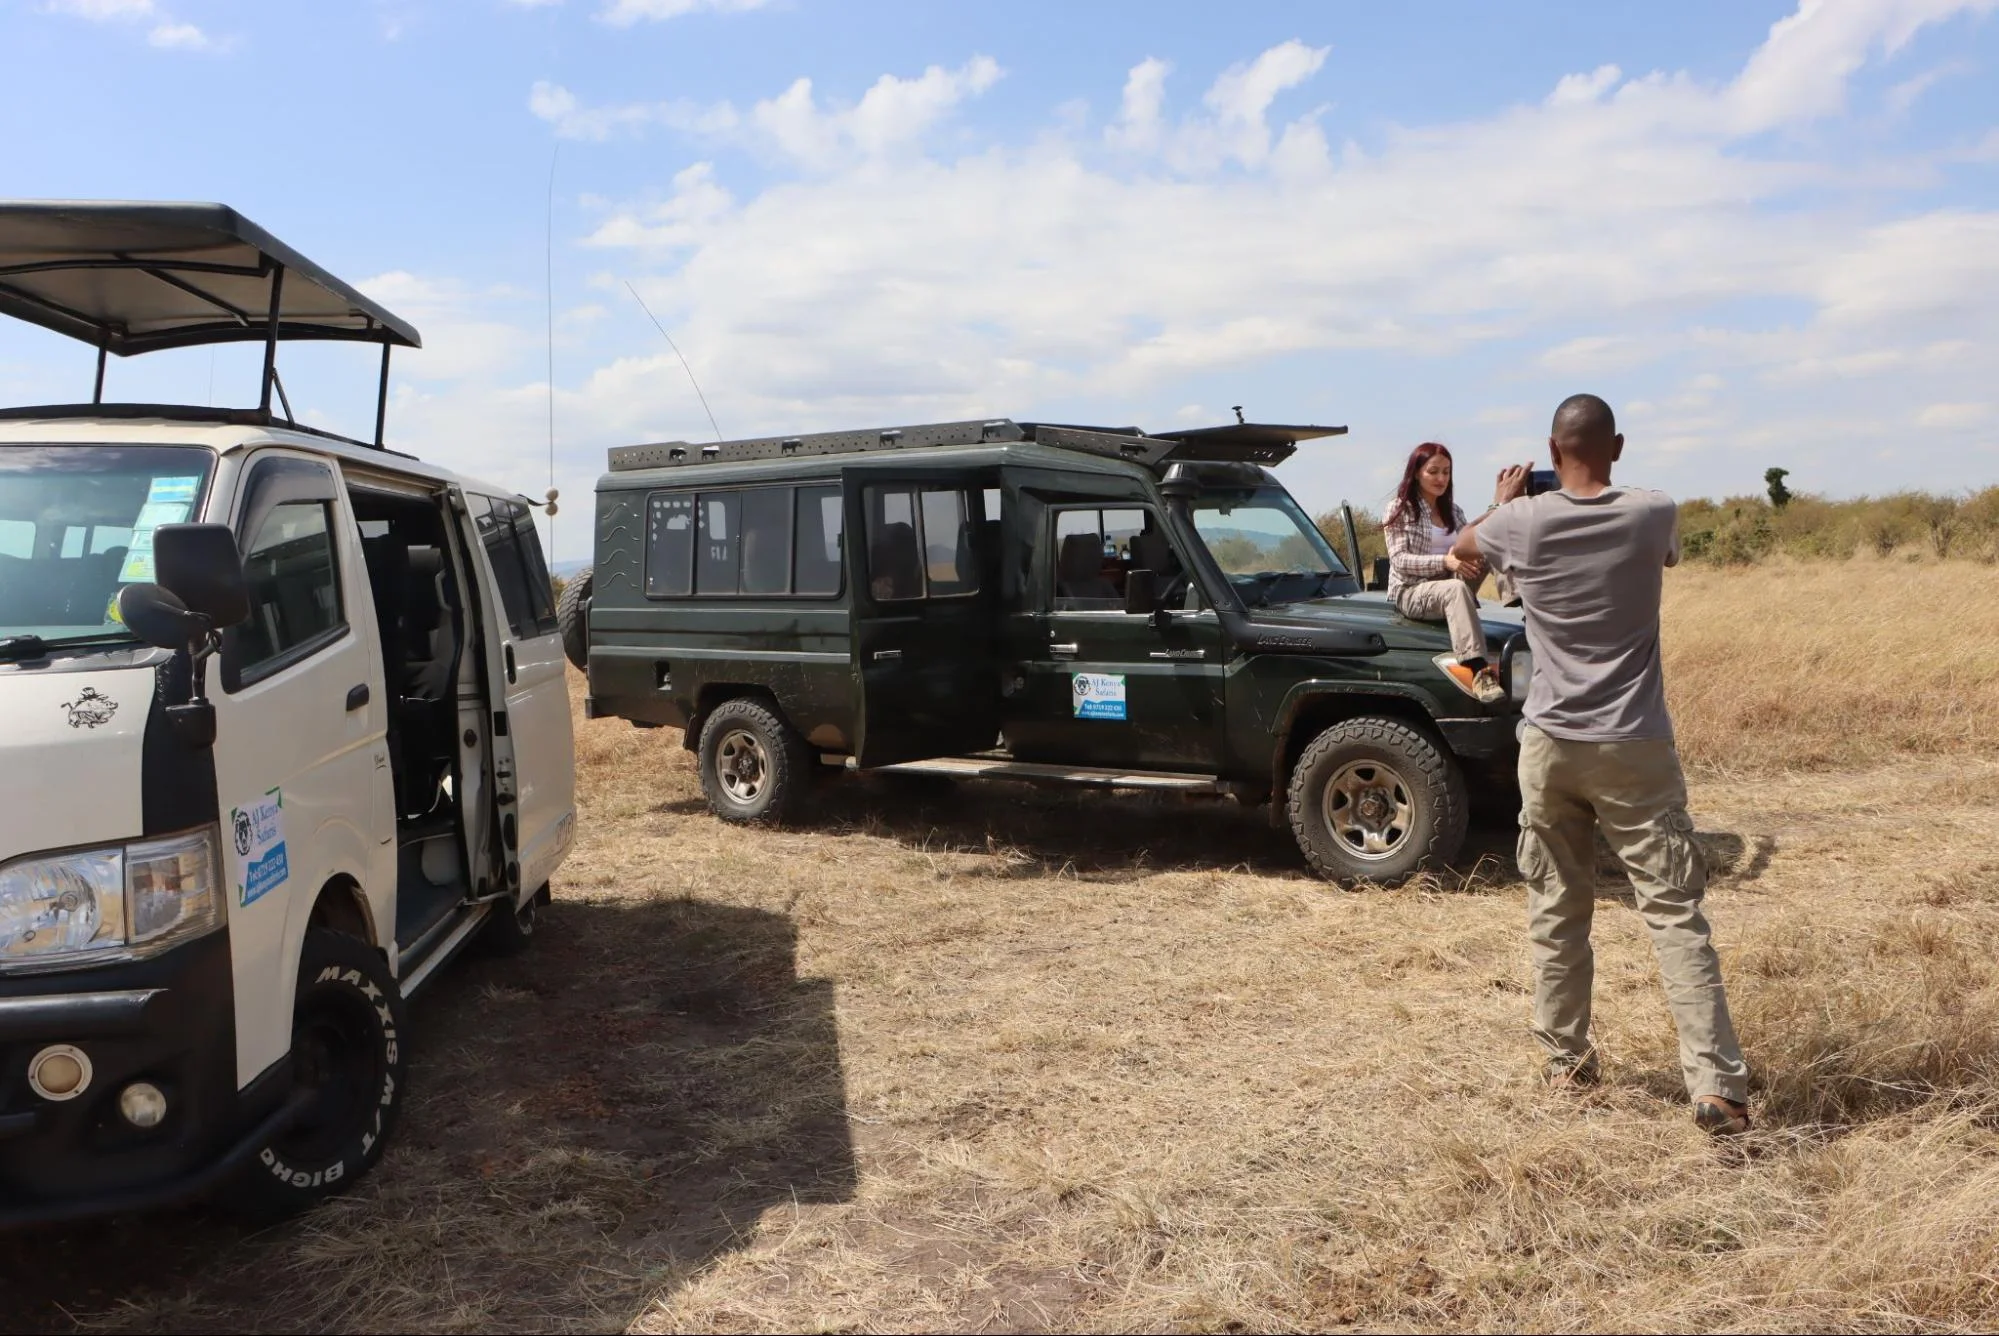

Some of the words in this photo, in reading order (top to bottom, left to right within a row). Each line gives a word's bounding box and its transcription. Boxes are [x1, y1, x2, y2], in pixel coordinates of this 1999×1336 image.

[1091, 679, 1099, 688] AJ
[1101, 679, 1121, 687] Kenya
[1095, 688, 1117, 696] Safaris
[260, 804, 279, 821] Kenya
[257, 826, 277, 845] Safaris
[315, 965, 398, 1065] MAXXIS
[259, 1147, 344, 1188] BIGHO
